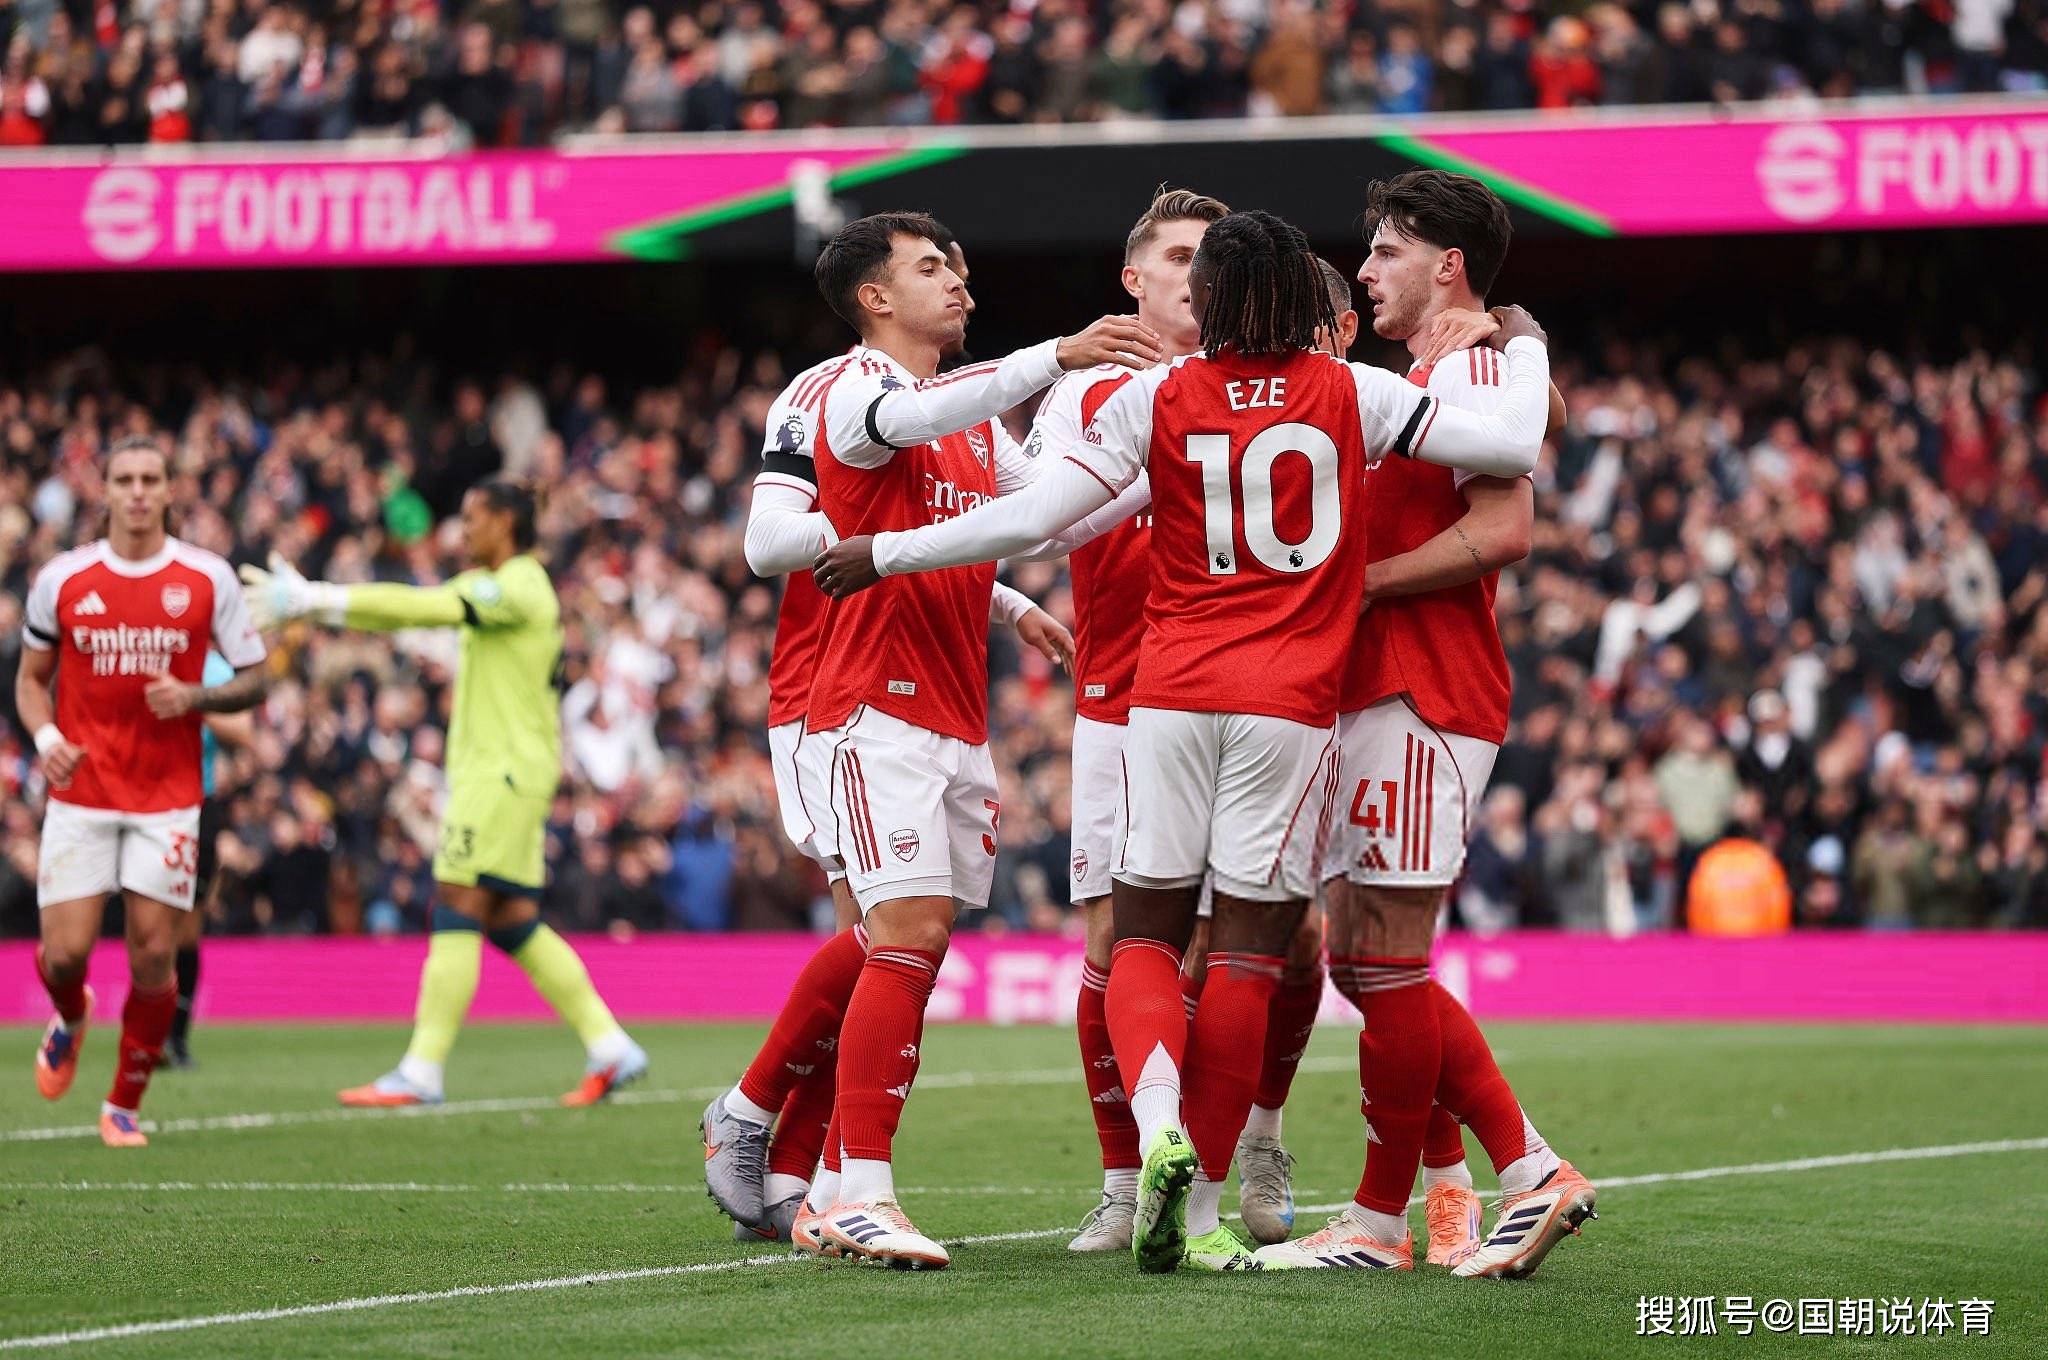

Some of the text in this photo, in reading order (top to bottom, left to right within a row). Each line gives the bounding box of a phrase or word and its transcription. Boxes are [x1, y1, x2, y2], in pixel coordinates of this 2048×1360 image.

[173, 164, 556, 254] FOOTBALL
[1225, 377, 1286, 411] EZE
[1186, 421, 1342, 575] 10
[1349, 778, 1398, 838] 41
